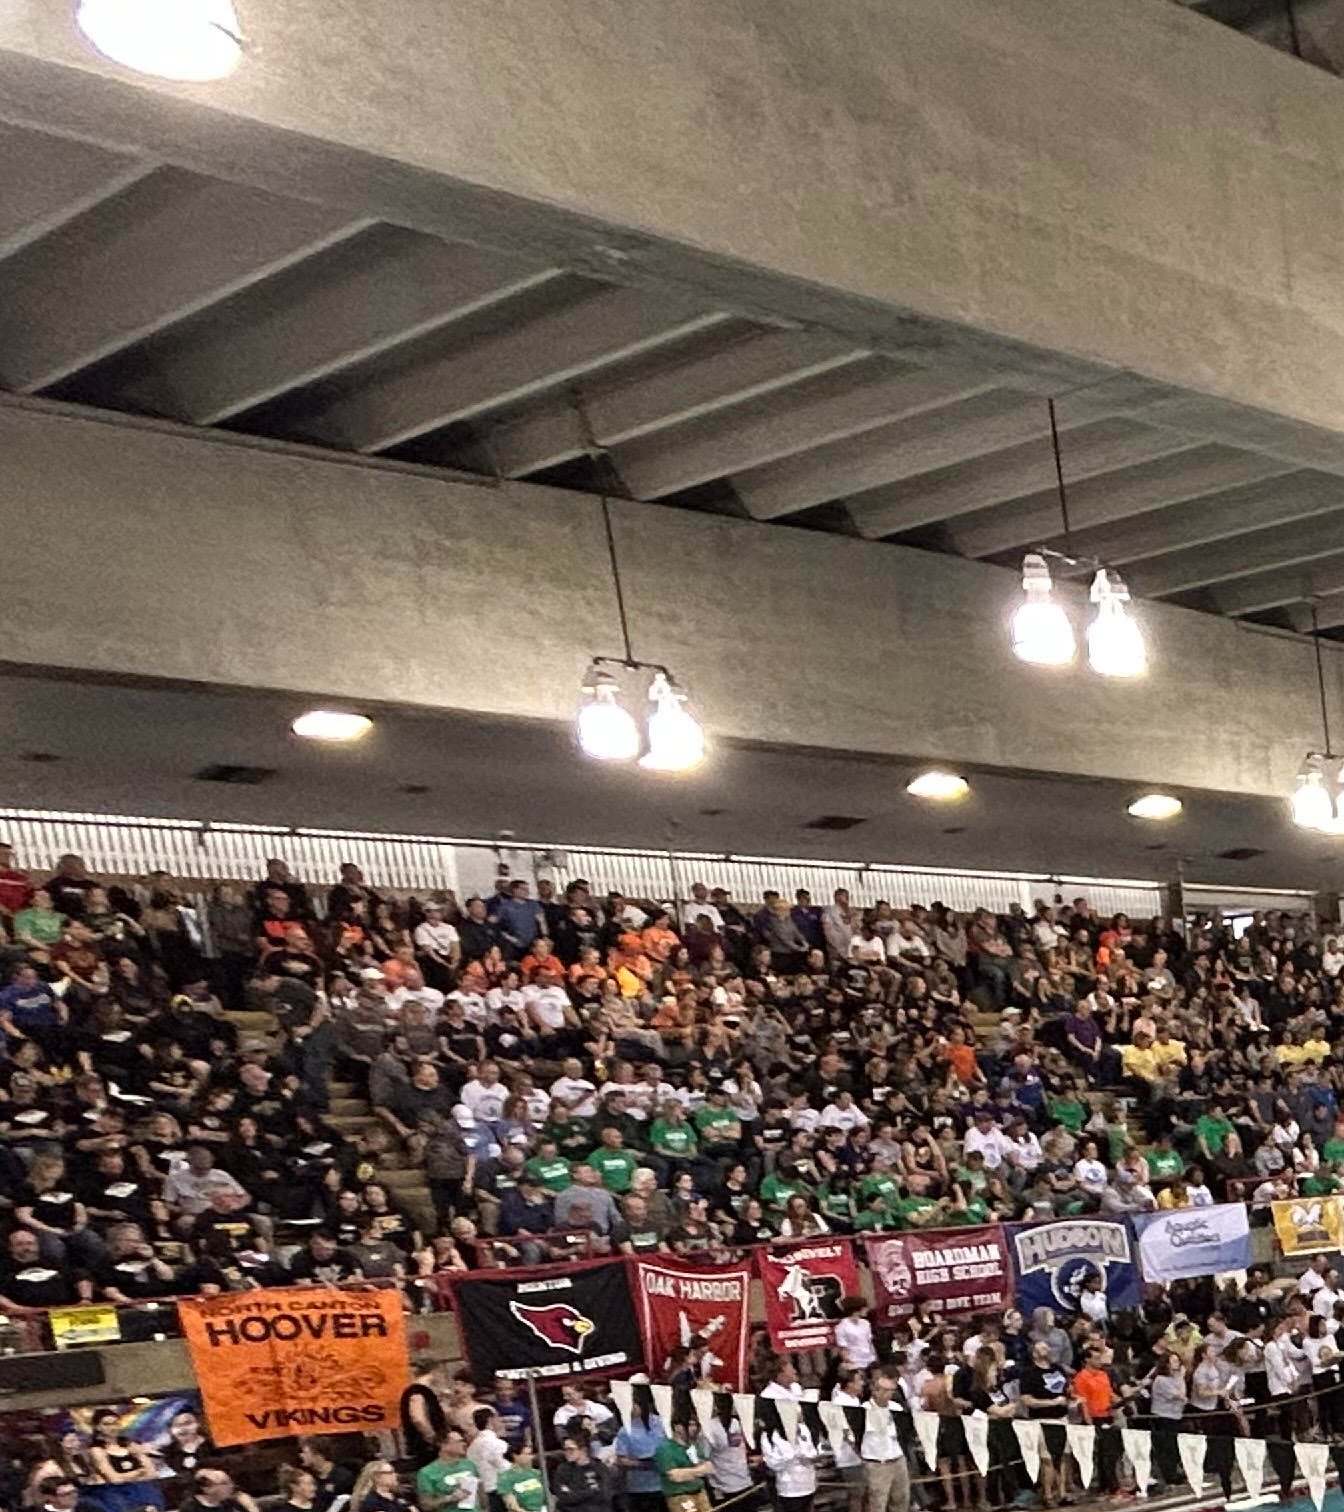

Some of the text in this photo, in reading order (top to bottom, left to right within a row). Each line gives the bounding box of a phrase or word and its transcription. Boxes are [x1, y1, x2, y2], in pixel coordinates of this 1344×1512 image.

[911, 1244, 1001, 1268] BOARDMAN
[1023, 1225, 1122, 1262] HUDSON
[953, 1262, 1003, 1281] SCHOOL
[647, 1272, 741, 1300] OAK HARBOR
[288, 1299, 380, 1311] CANTON
[205, 1313, 388, 1348] HOOVER
[245, 1404, 386, 1430] VIKINGS
